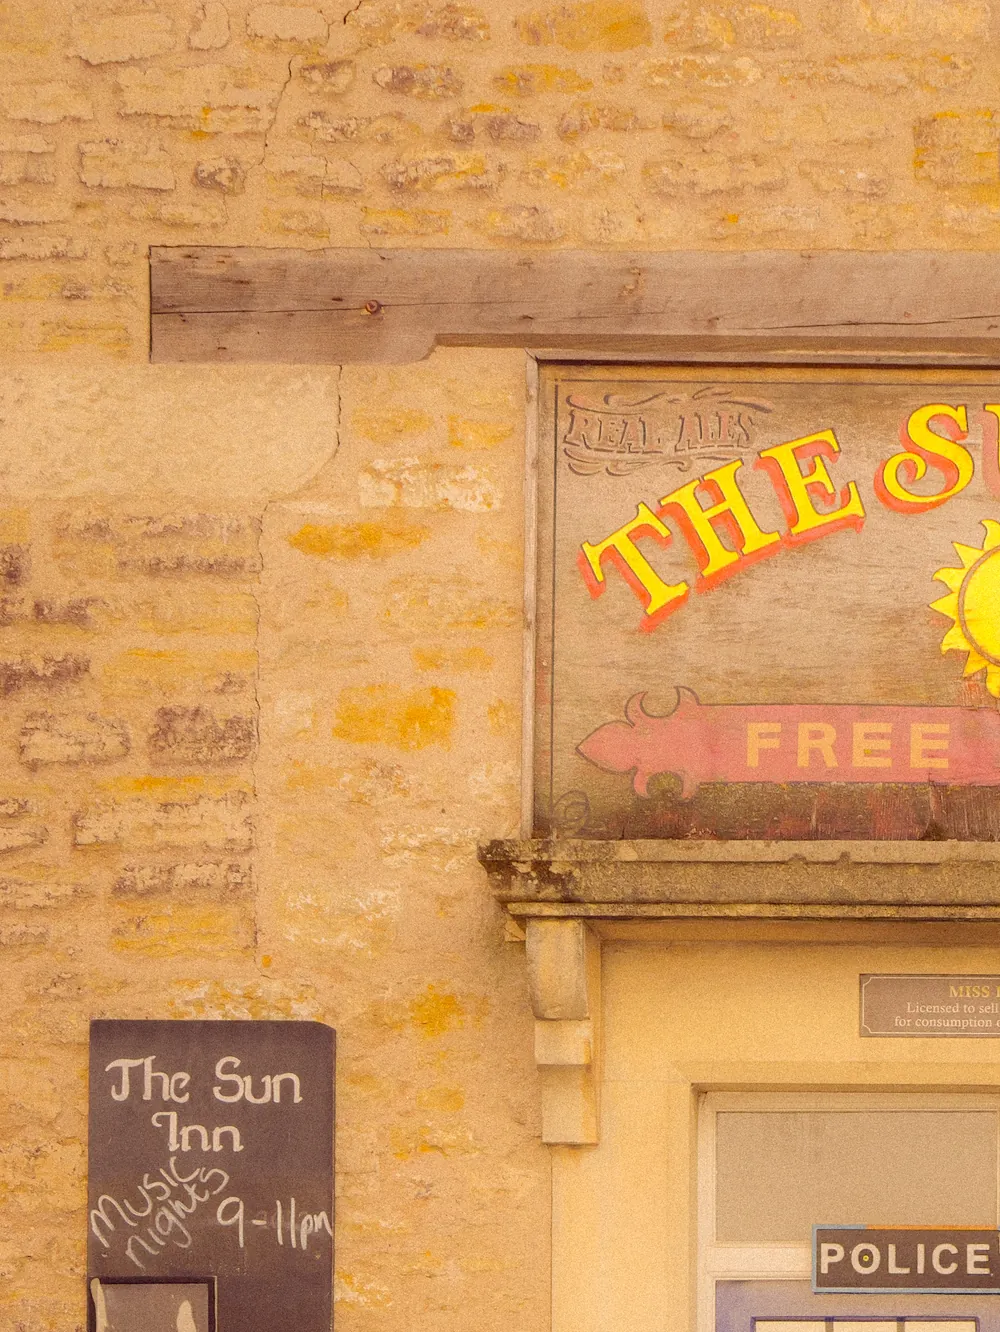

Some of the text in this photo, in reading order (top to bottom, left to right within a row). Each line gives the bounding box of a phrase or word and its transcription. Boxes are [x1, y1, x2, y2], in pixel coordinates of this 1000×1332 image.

[563, 409, 757, 454] REAL ALES
[579, 428, 866, 620] THE
[746, 722, 951, 770] FREE
[906, 1001, 960, 1014] Licensed
[963, 1003, 975, 1014] to
[979, 1002, 999, 1014] sell
[949, 985, 990, 998] MISS
[894, 1015, 912, 1027] for
[915, 1016, 993, 1030] consumption
[104, 1055, 304, 1104] The Sun
[151, 1111, 245, 1153] Inn
[820, 1242, 991, 1276] POLICE
